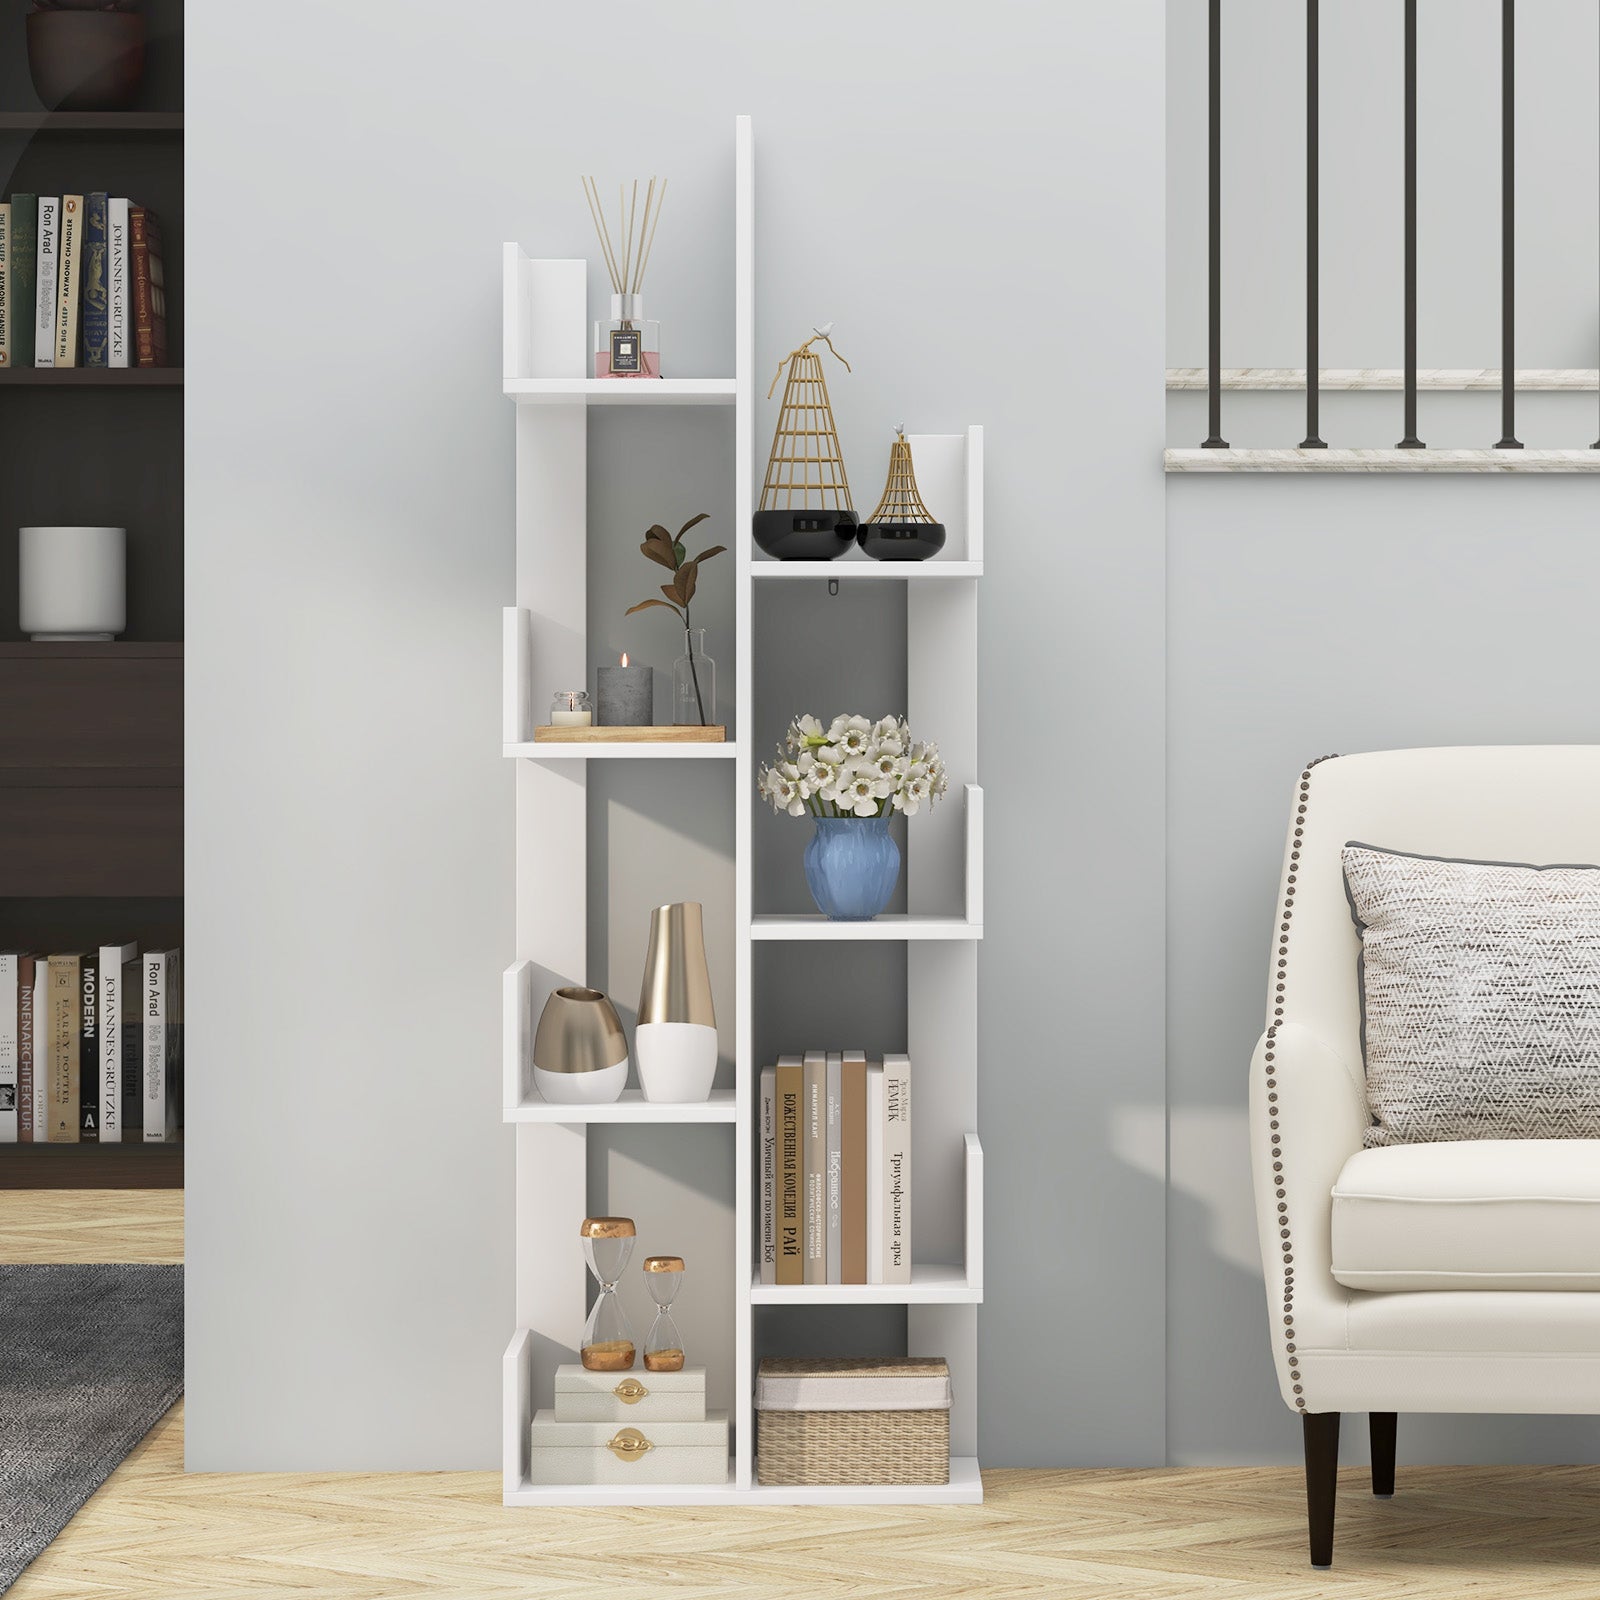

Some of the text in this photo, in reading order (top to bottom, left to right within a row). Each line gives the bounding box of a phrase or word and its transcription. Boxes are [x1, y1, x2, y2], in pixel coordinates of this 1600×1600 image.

[43, 205, 54, 226] Ron
[65, 218, 73, 258] CHANDLER
[42, 229, 54, 254] Arad
[63, 260, 71, 298] RAYMOND
[113, 223, 123, 358] JOHANNES GRÜTZKE
[149, 962, 161, 986] Ron
[83, 968, 95, 1038] MODERN
[149, 989, 161, 1017] Arad
[21, 985, 32, 1131] INNENARCHITEKTUR
[62, 998, 70, 1104] HARRY POTTER
[105, 976, 117, 1130] JOHANNES GRÜTZKE
[84, 1113, 95, 1128] A
[888, 1079, 899, 1122] РЕМАРК
[782, 1093, 797, 1218] БОЖЕСТВЕННАЯ КОМЕДИЯ
[828, 1151, 841, 1209] Избранное
[764, 1137, 775, 1263] Уличный кот по имени Боб
[890, 1151, 904, 1266] Триумфальная арка
[783, 1227, 801, 1256] РАЙ
